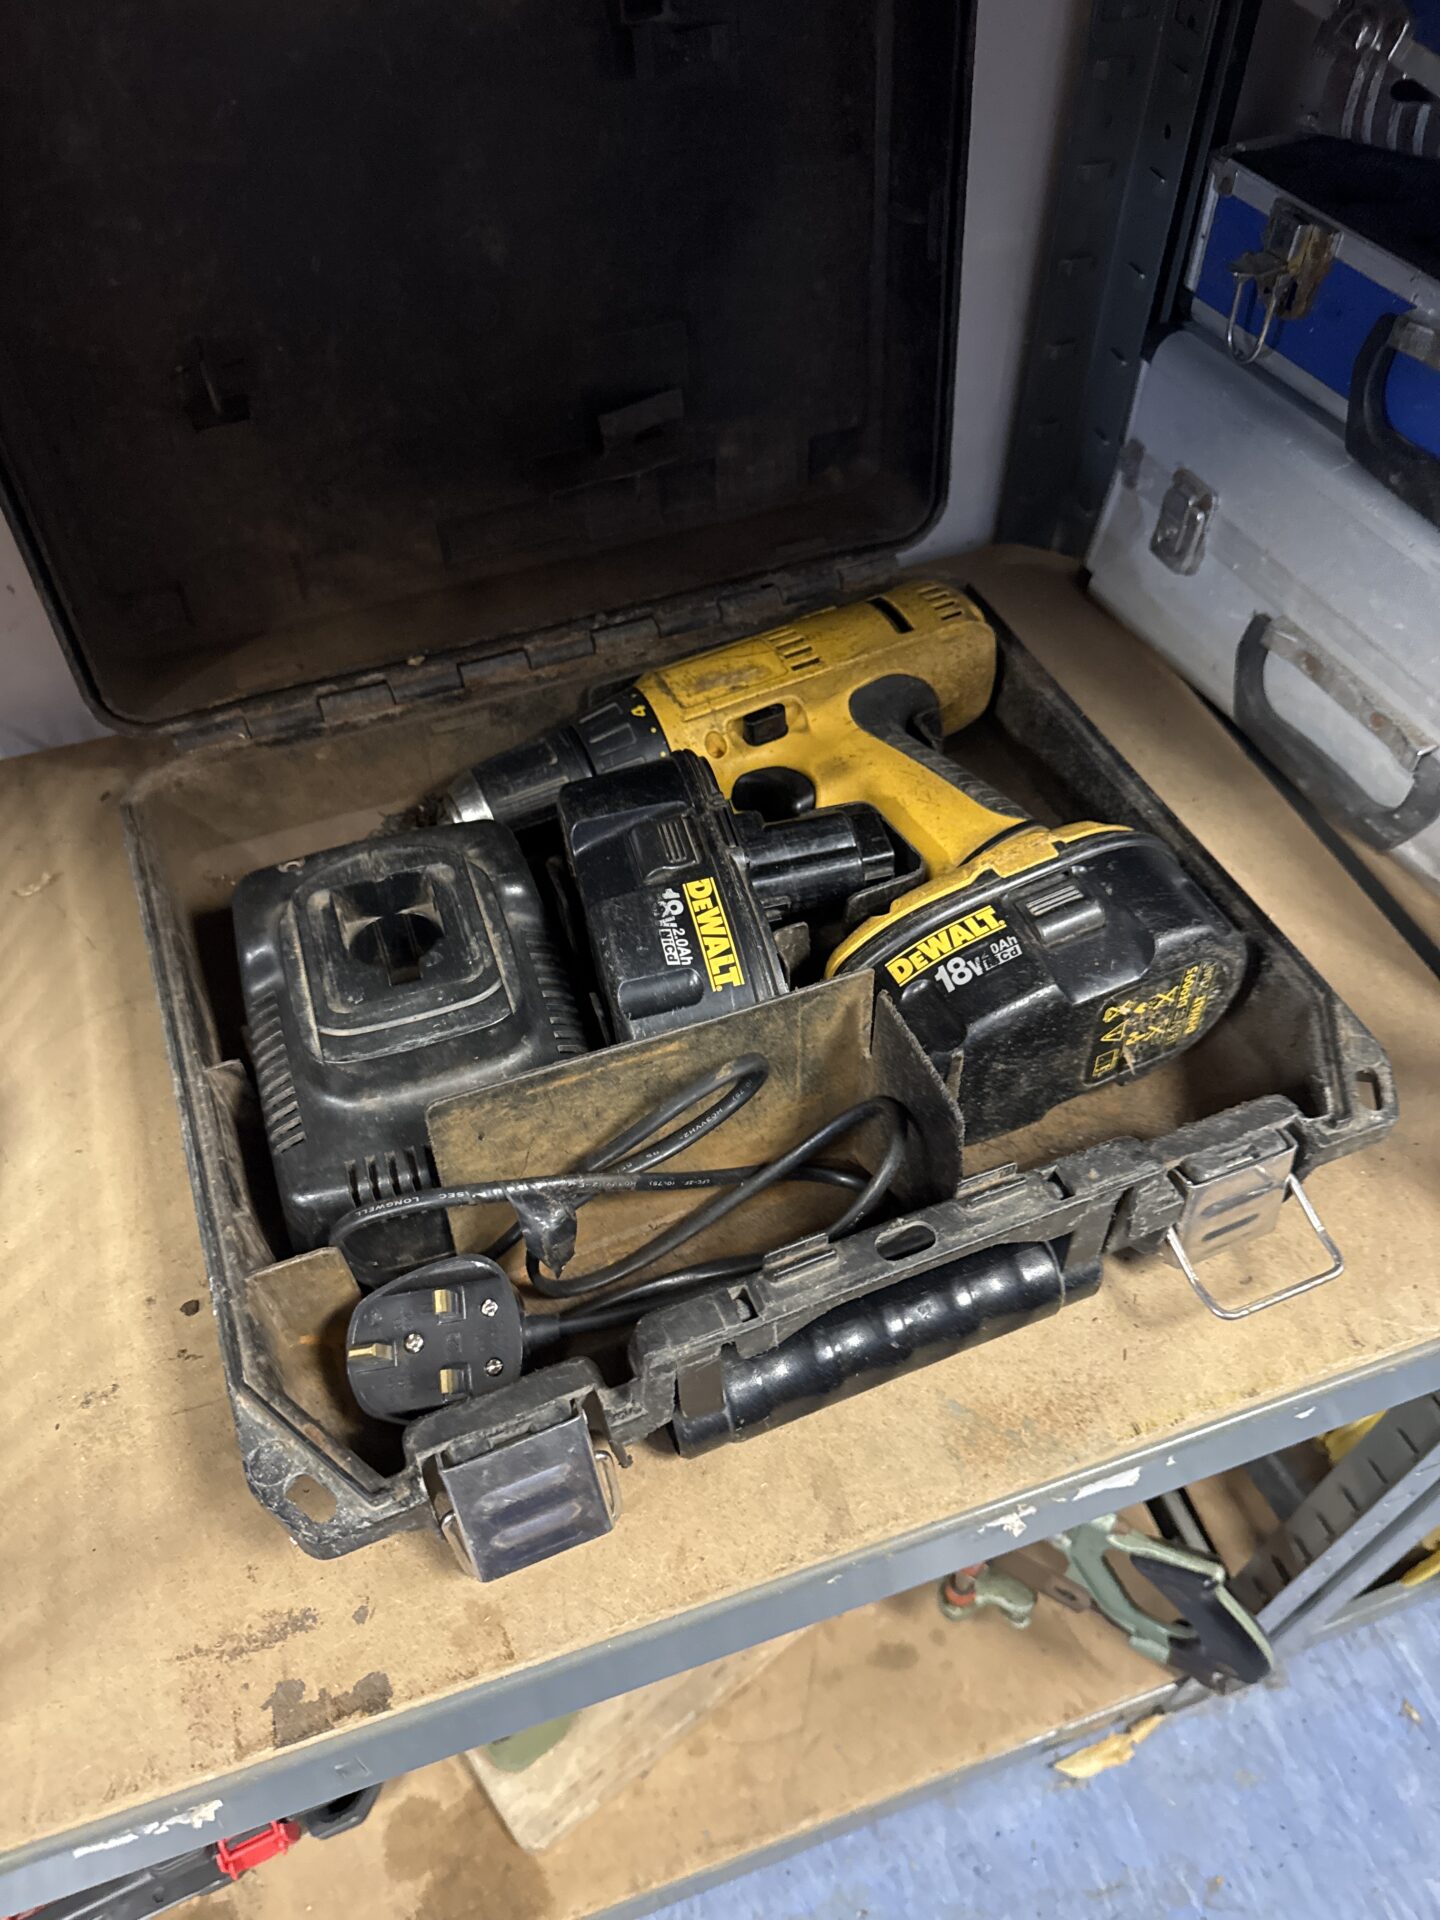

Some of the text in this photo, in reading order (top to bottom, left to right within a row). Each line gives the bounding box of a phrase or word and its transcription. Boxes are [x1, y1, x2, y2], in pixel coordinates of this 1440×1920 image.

[659, 928, 681, 966] NiCd
[672, 928, 693, 966] 2.0Ah
[684, 877, 743, 988] DEWALT
[886, 907, 1003, 985] DEWALT
[354, 1195, 421, 1218] LONGWELL
